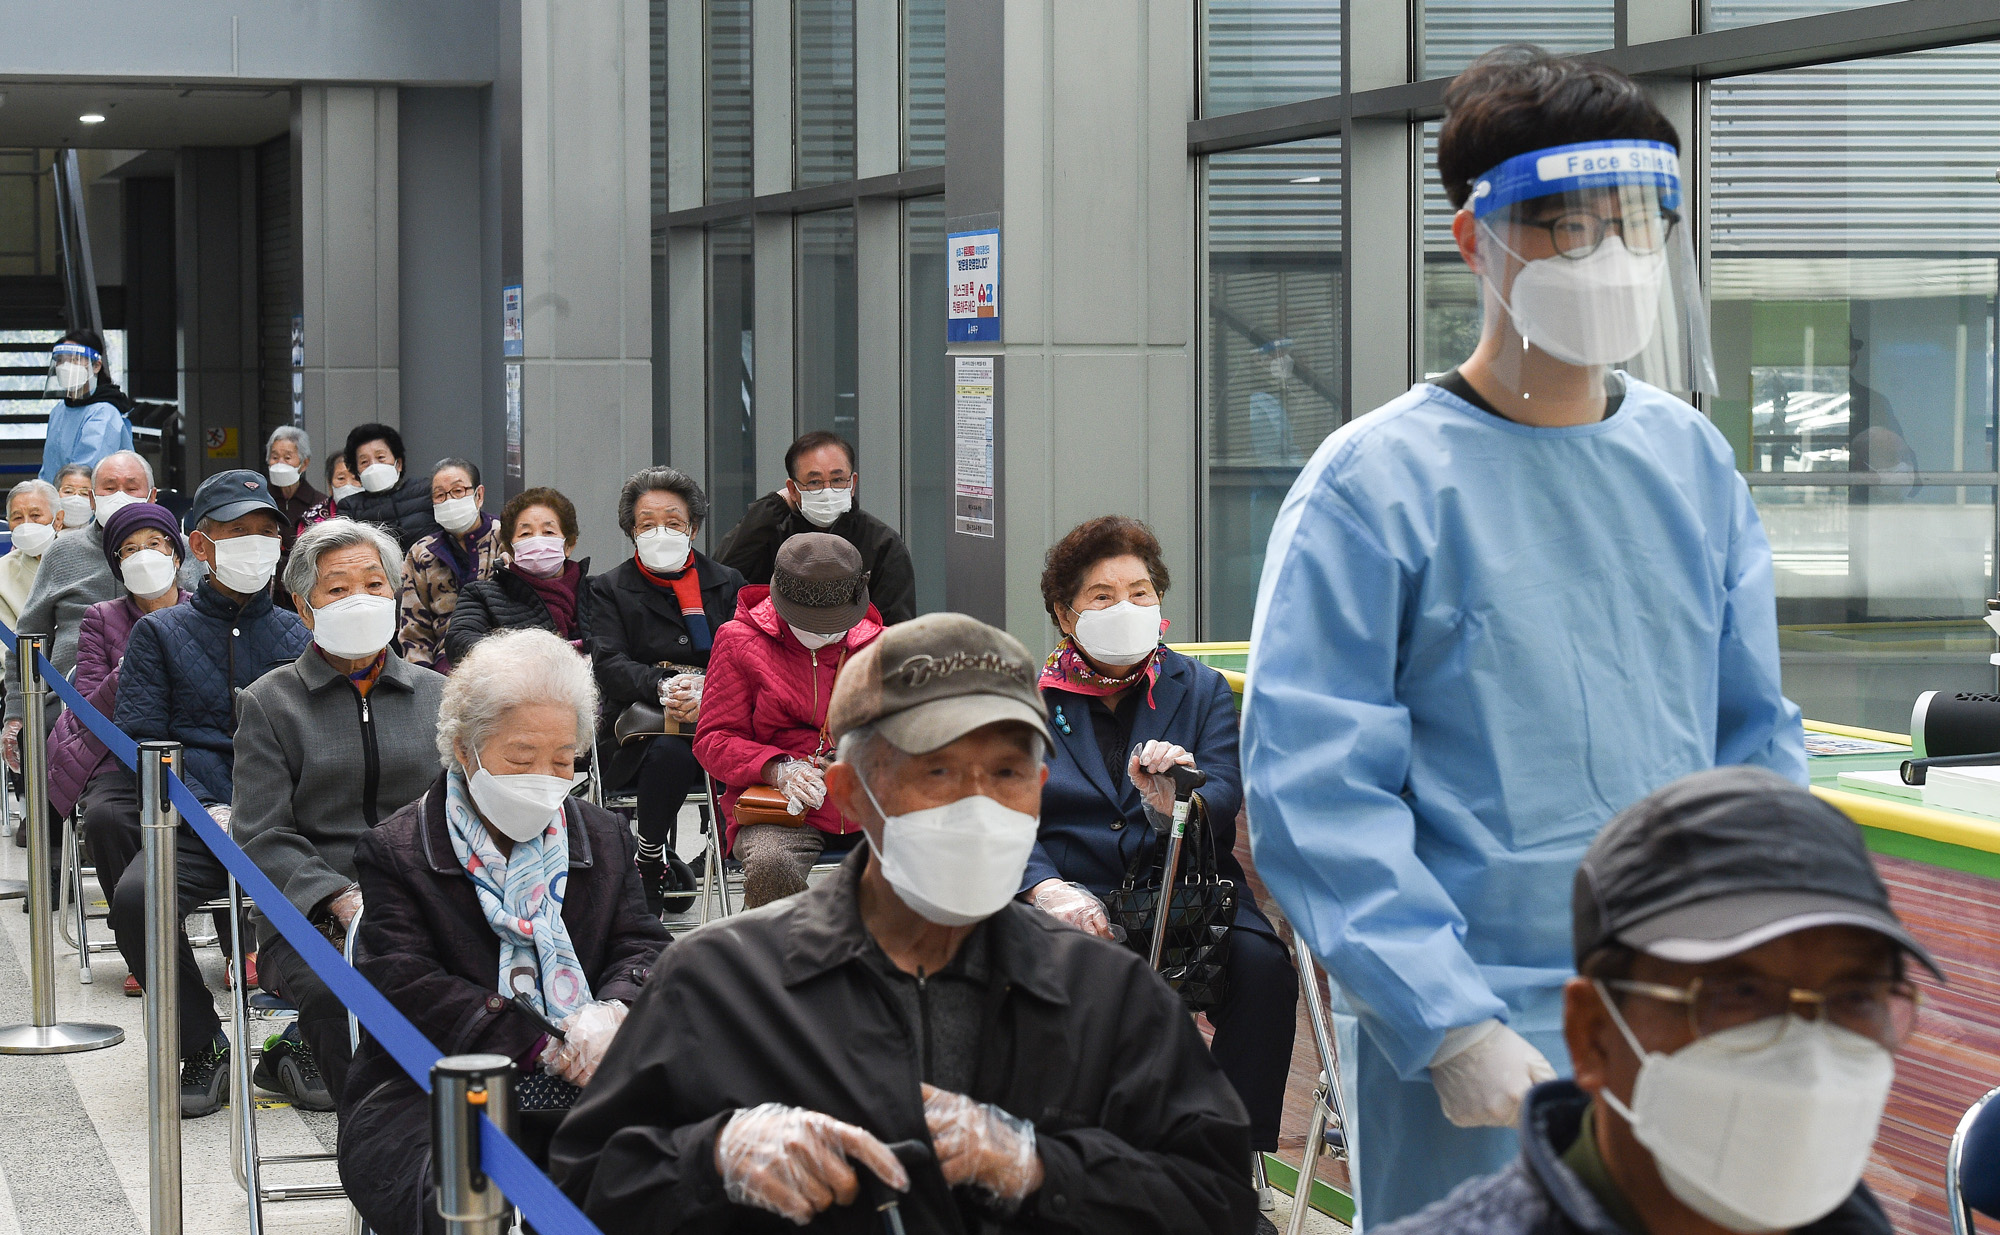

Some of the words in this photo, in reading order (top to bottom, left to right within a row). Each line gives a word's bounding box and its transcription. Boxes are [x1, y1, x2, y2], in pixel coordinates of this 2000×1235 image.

[1566, 154, 1620, 173] Face
[1629, 152, 1674, 171] Shied
[954, 283, 969, 296] 마스크를
[953, 300, 975, 313] 착용해주세요
